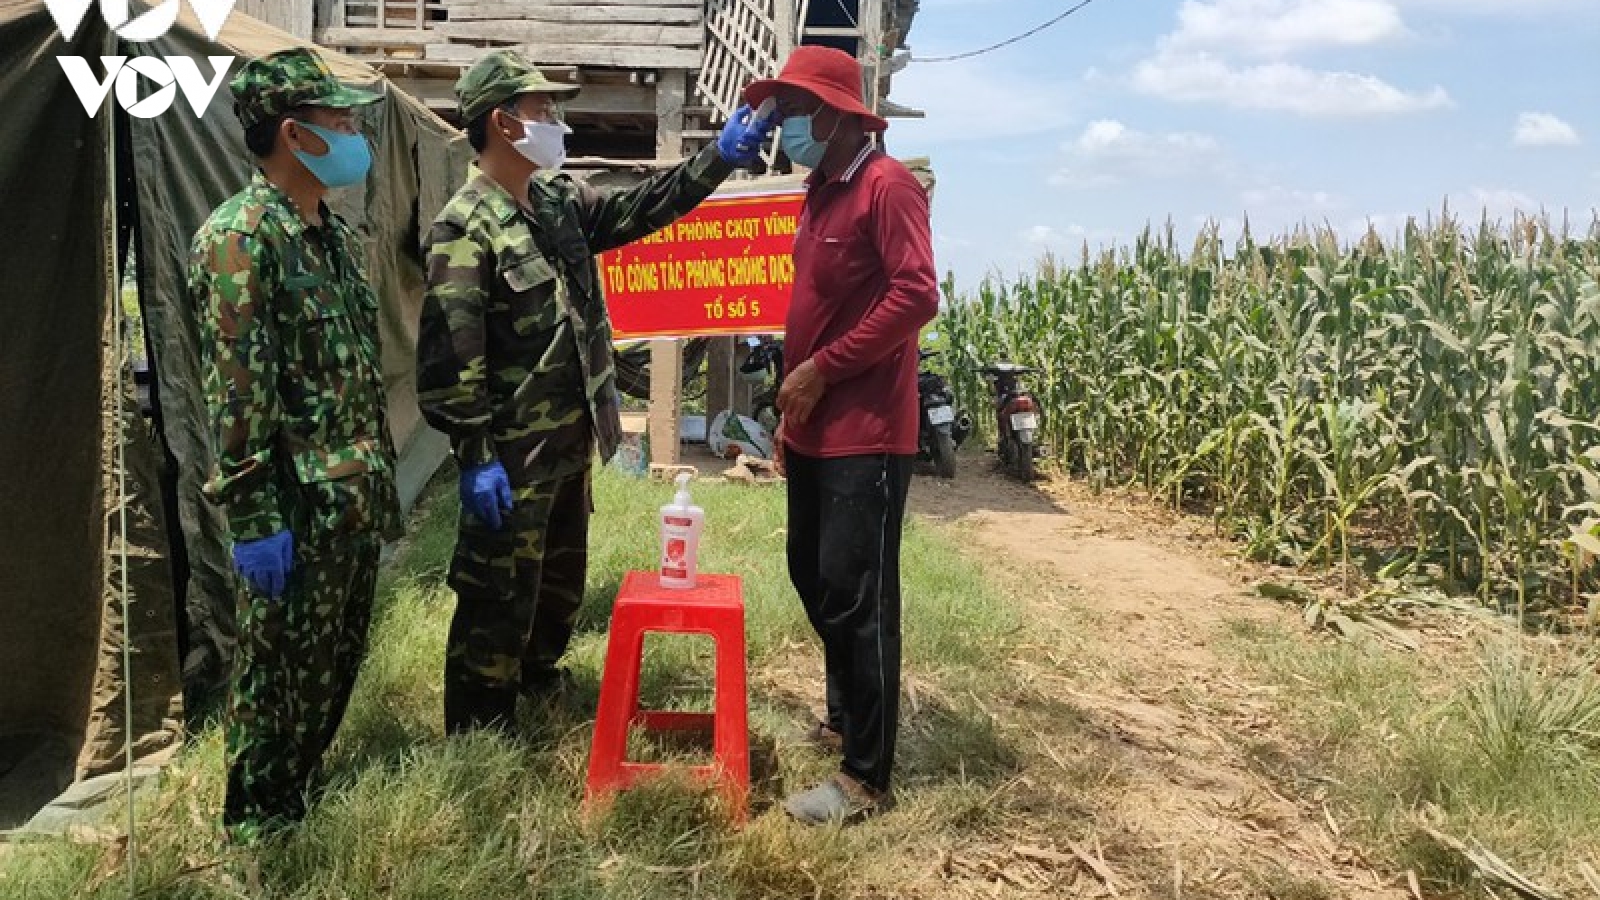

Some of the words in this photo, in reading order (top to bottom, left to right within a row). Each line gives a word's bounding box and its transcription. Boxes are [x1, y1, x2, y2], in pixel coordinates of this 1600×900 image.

[608, 250, 625, 294] TỔ
[627, 256, 659, 293] CÔNG
[660, 254, 684, 291] TÁC
[686, 252, 725, 289] PHÒNG
[728, 245, 767, 287] CHỐNG
[704, 295, 723, 319] TỔ
[728, 296, 747, 317] SỐ
[752, 300, 761, 317] 5
